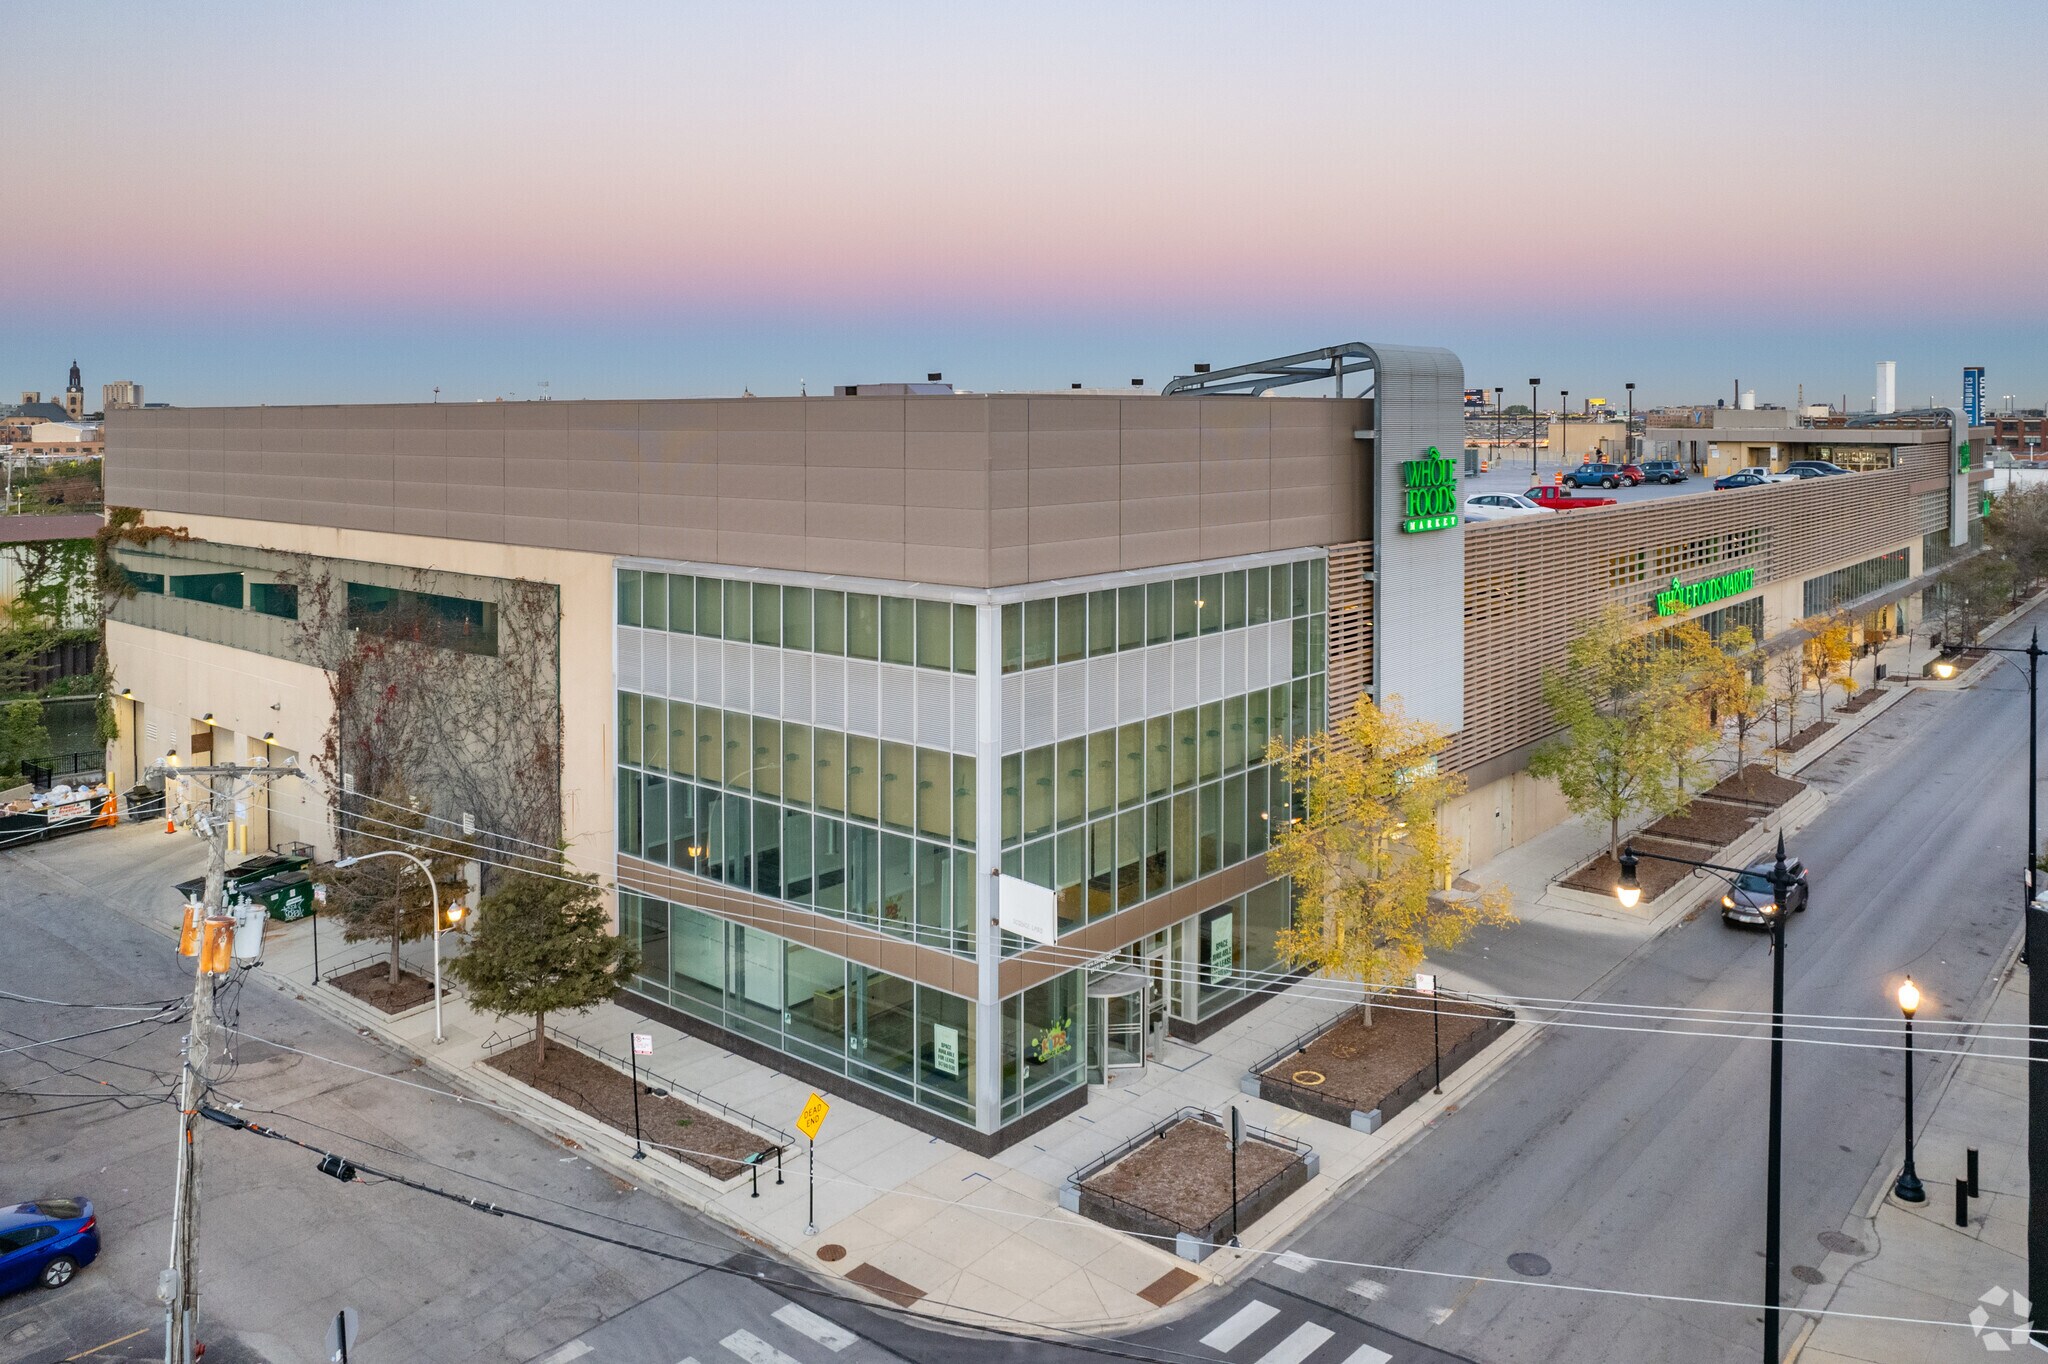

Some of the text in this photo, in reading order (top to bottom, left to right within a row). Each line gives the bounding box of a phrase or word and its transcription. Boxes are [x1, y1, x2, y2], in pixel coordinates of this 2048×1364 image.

[1404, 459, 1457, 487] WHOLE
[1407, 486, 1456, 516] FOODS
[1410, 517, 1455, 530] MARKET
[1692, 577, 1721, 608] FOODS
[1722, 568, 1754, 599] MARKET
[1216, 939, 1228, 951] SPACE
[804, 1104, 821, 1119] DEAD
[807, 1115, 819, 1127] END
